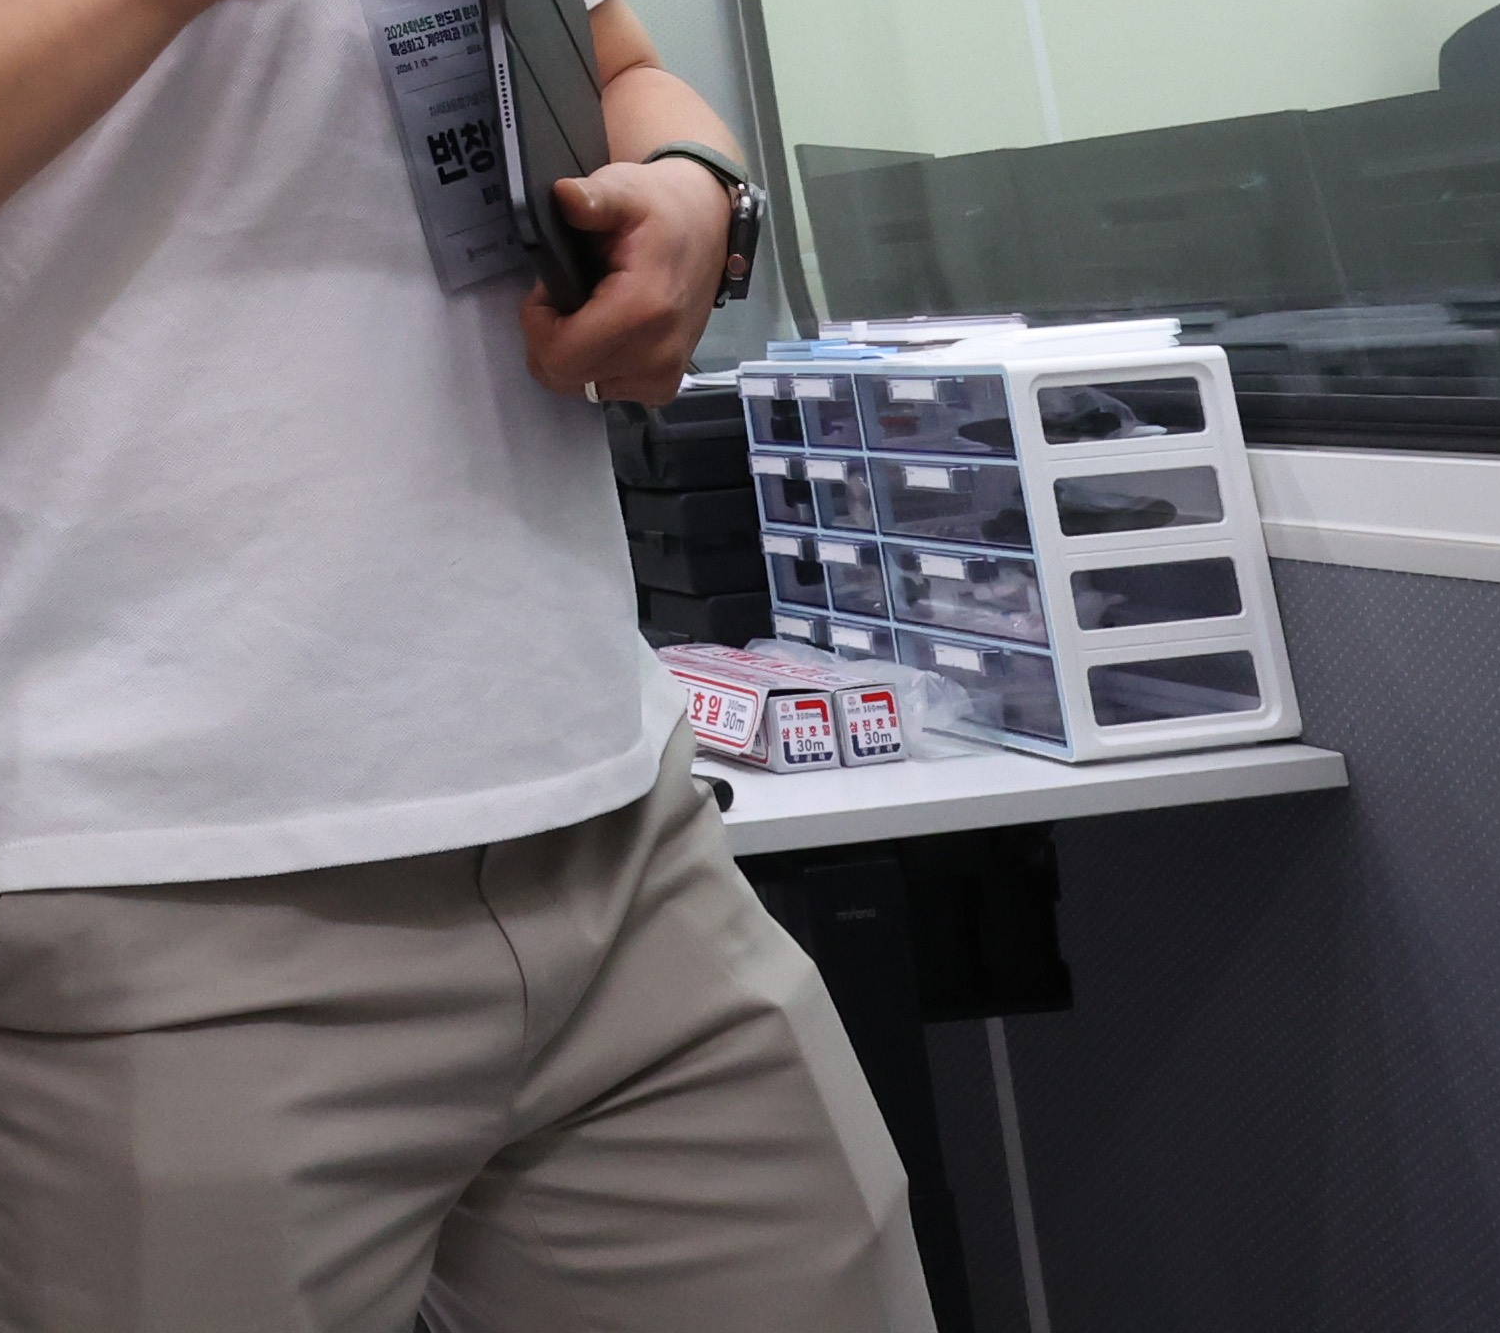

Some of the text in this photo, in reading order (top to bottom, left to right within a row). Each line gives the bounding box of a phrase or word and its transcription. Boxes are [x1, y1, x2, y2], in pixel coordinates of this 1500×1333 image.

[384, 15, 435, 41] 2024학년도
[435, 8, 463, 28] 반도체
[389, 36, 425, 57] 특성화고
[425, 27, 462, 48] 계약학과
[427, 119, 497, 186] 변창
[690, 691, 723, 727] 호일
[723, 710, 745, 733] 30m
[796, 738, 825, 753] 30m
[864, 730, 892, 745] 30m
